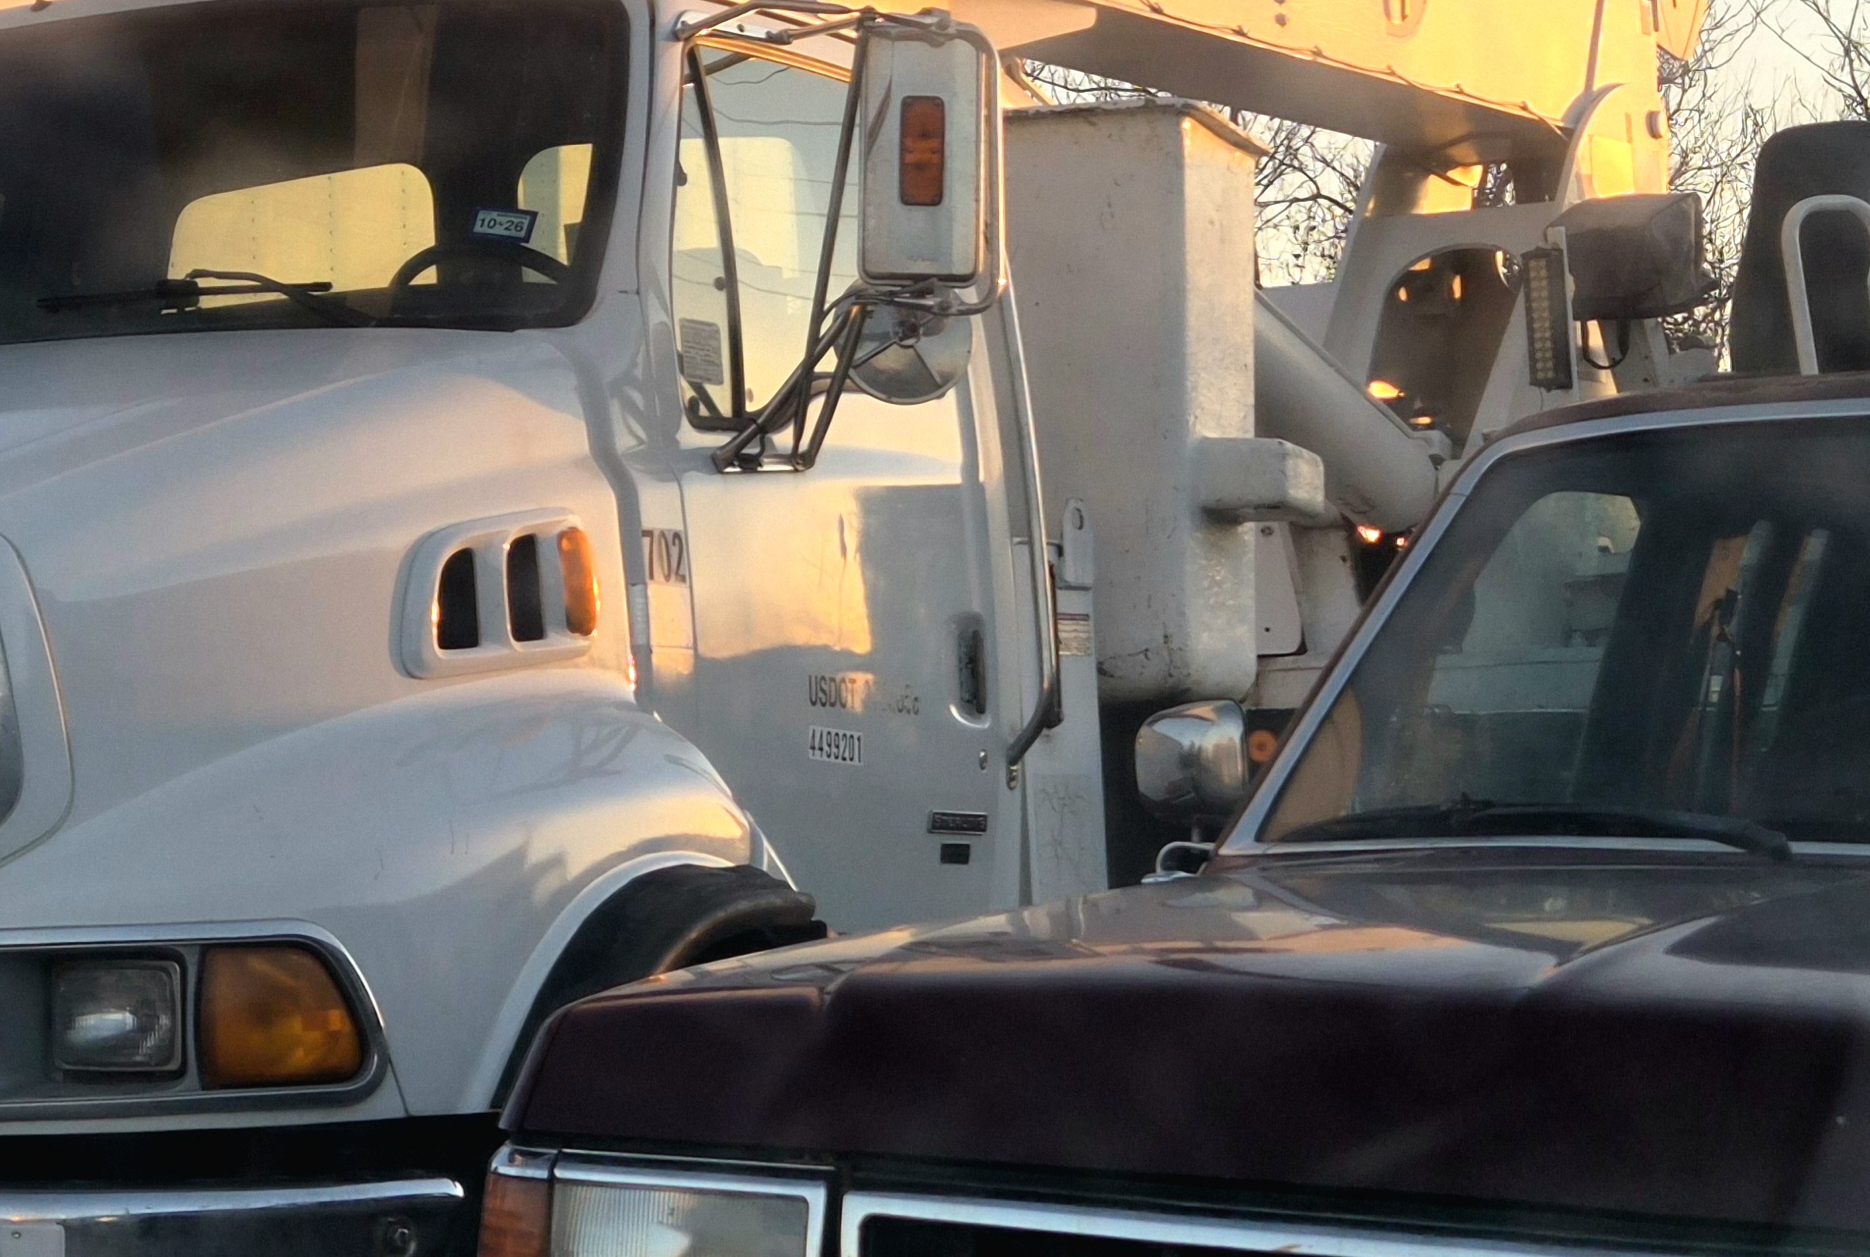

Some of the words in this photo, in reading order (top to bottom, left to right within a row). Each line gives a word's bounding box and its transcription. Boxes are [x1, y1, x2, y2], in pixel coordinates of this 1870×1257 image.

[641, 529, 687, 584] 702
[808, 674, 857, 710] USDOT
[809, 728, 862, 764] 4499201
